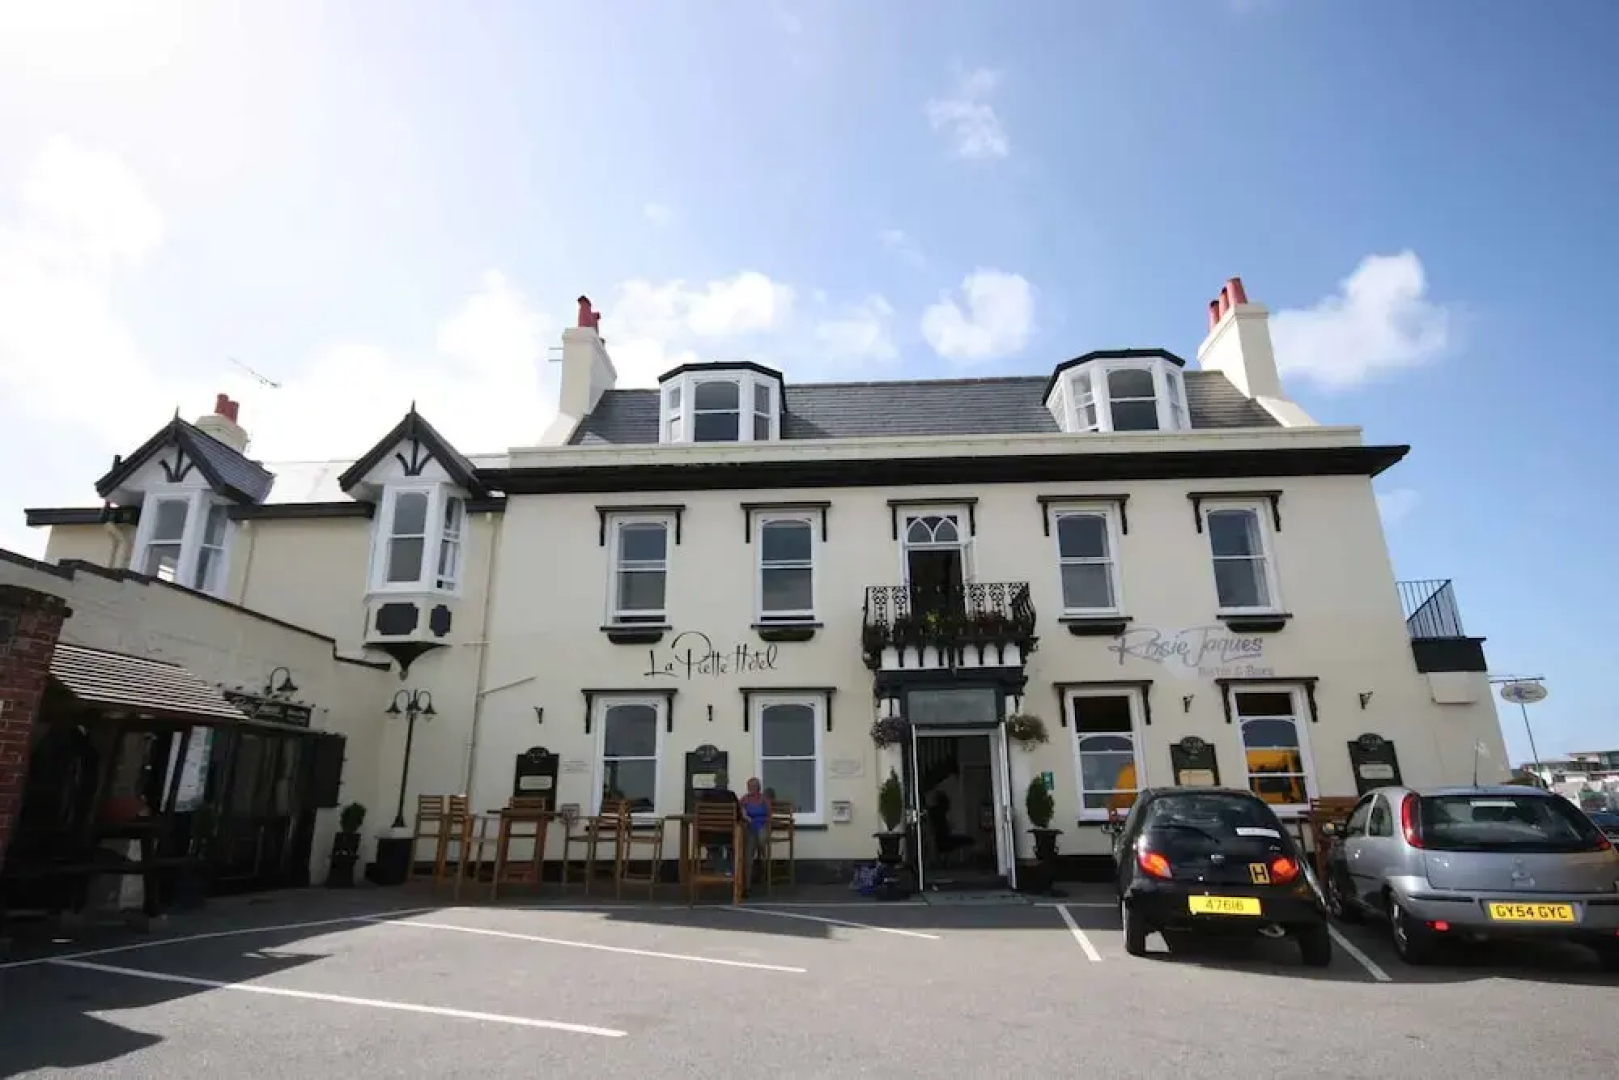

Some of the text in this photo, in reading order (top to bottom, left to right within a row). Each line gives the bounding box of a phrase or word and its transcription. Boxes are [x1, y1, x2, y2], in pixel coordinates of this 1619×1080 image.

[643, 648, 679, 678] La
[732, 642, 778, 674] Hotel
[1107, 625, 1265, 668] Rosie Jaques
[1252, 864, 1268, 882] H
[1495, 904, 1569, 920] GY54 GYC
